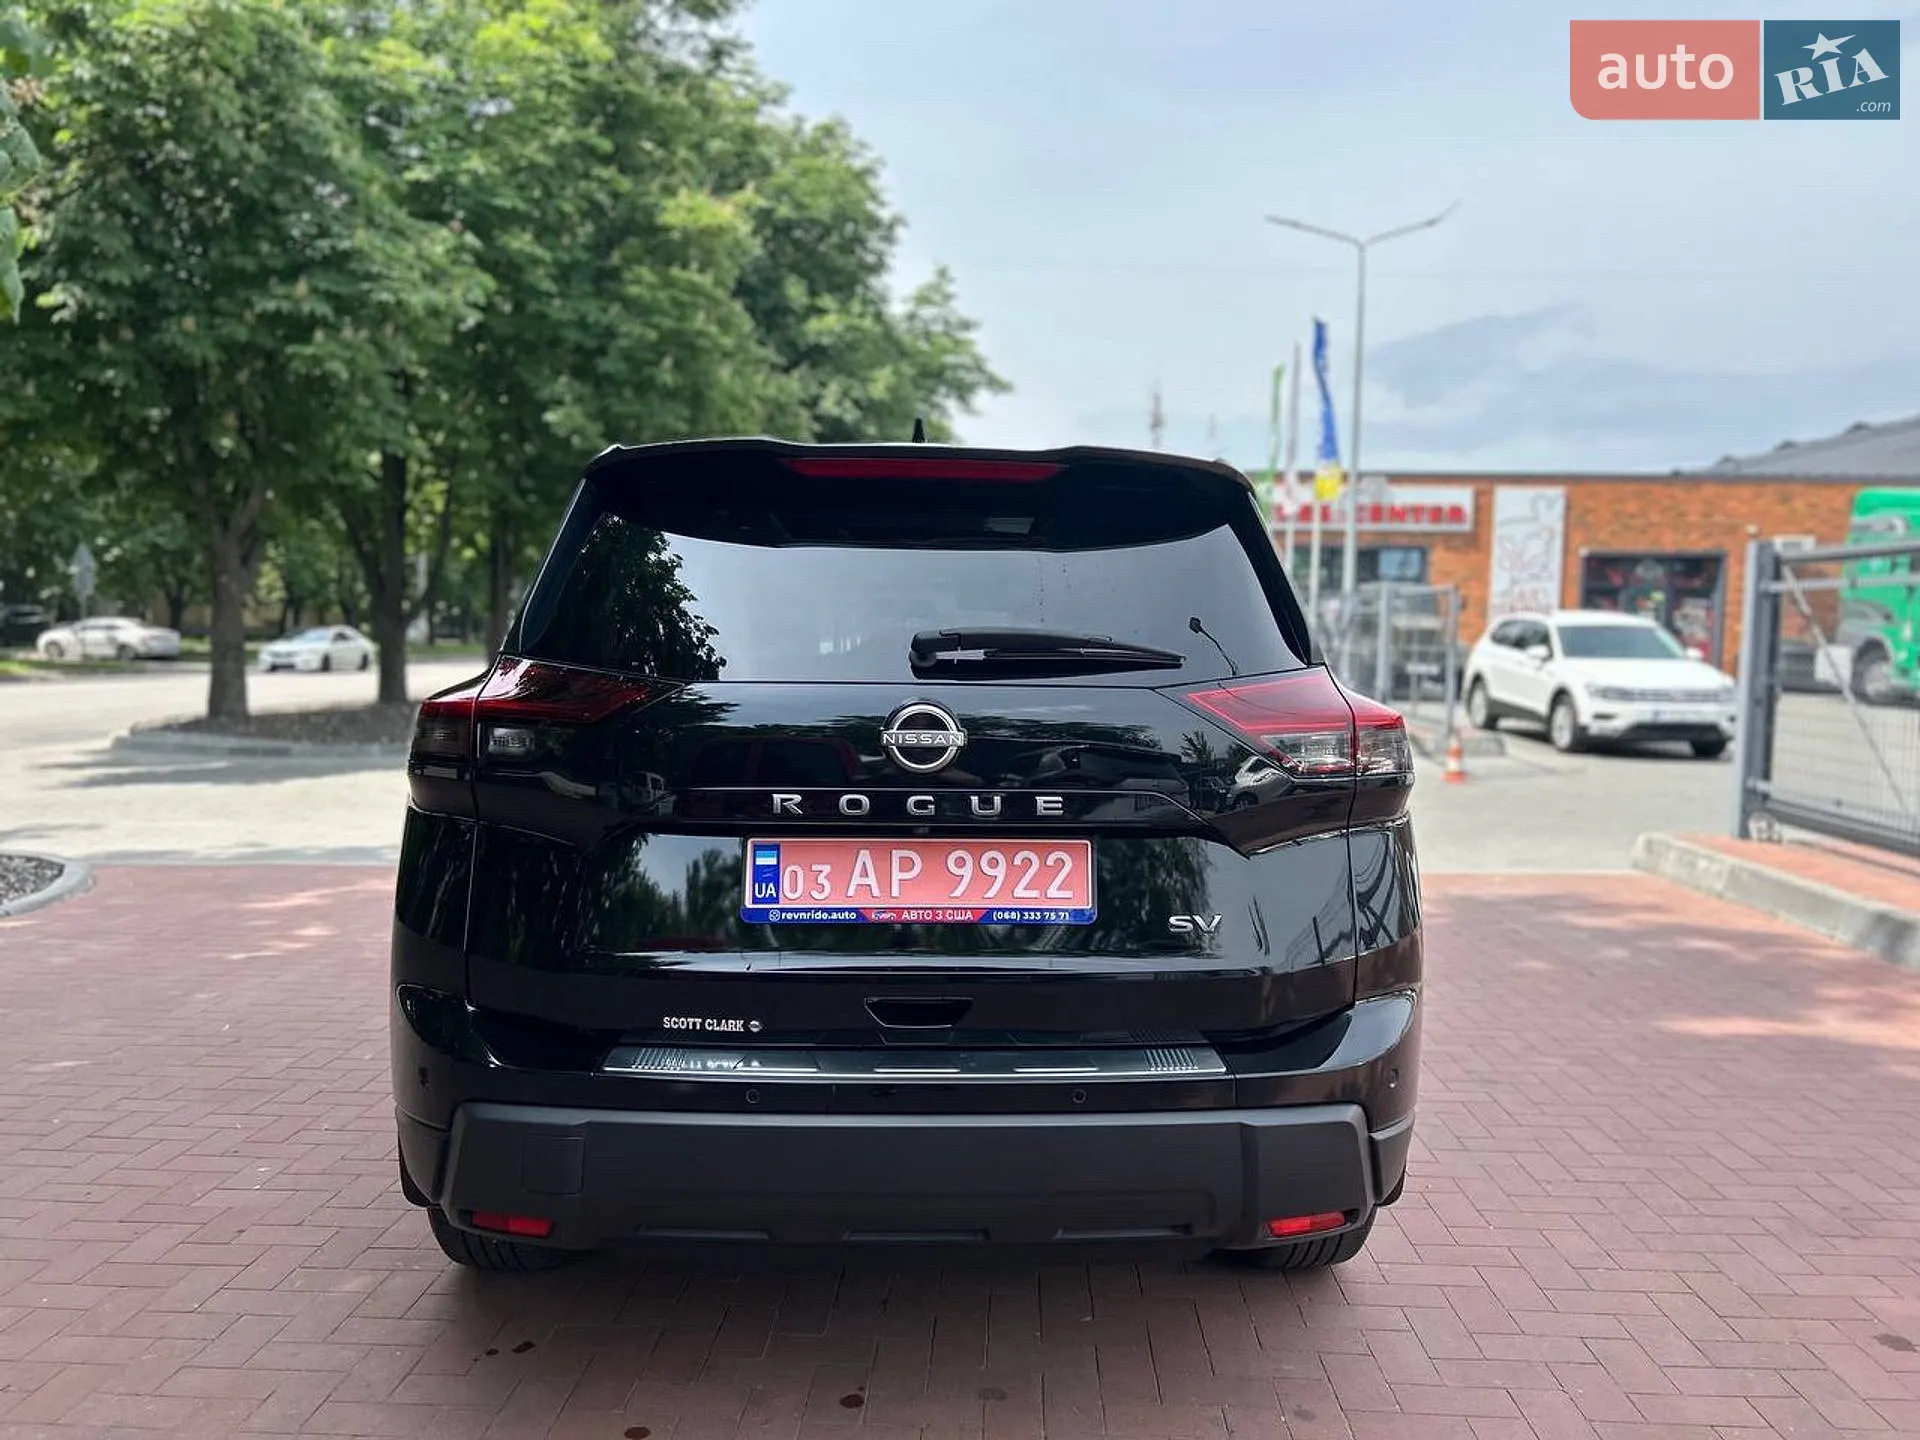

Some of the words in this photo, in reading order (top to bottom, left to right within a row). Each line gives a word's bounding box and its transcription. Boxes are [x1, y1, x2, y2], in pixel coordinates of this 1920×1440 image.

[882, 732, 964, 746] NISSAN
[771, 793, 1065, 817] ROGUE
[754, 882, 777, 898] UA
[783, 864, 833, 900] 03
[846, 849, 922, 898] AP
[946, 850, 1074, 899] 9922
[901, 910, 933, 921] АВТО
[945, 910, 974, 921] США
[1168, 914, 1223, 932] SV
[662, 1016, 702, 1030] SCOTT
[704, 1018, 745, 1032] CLARK
